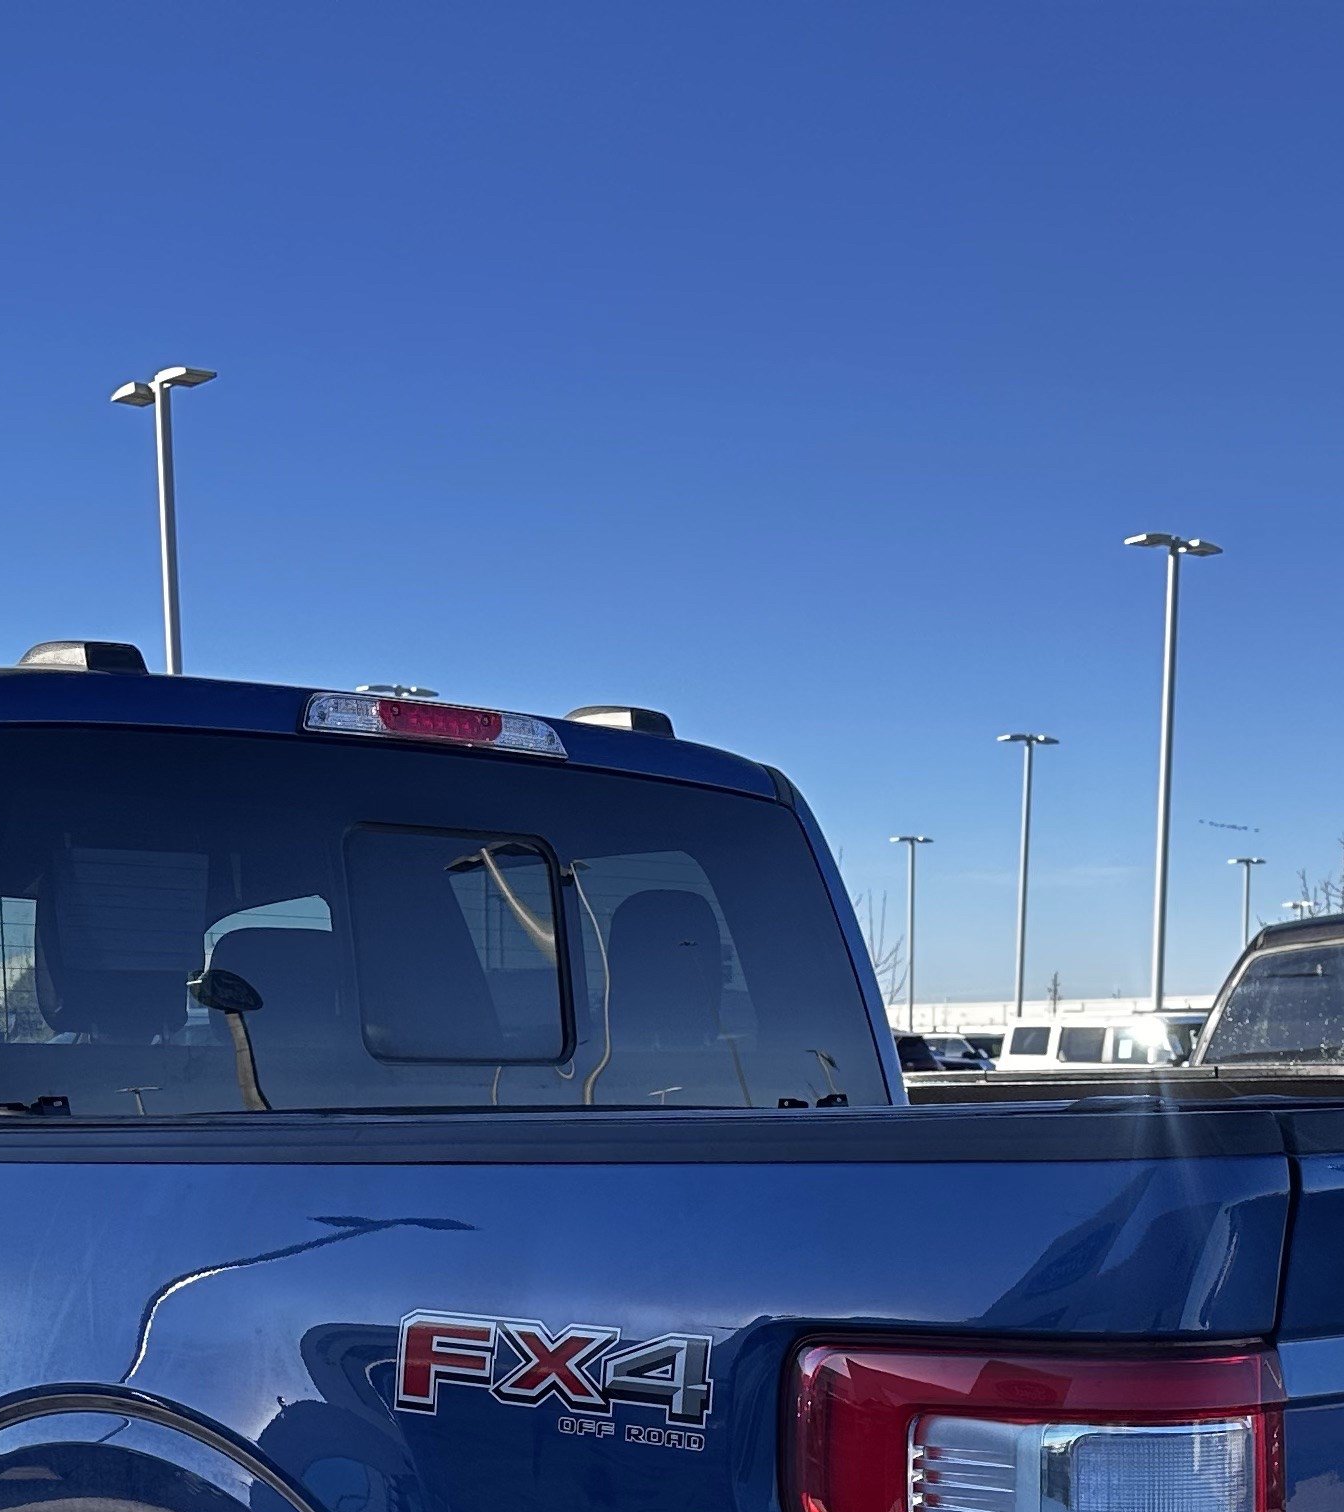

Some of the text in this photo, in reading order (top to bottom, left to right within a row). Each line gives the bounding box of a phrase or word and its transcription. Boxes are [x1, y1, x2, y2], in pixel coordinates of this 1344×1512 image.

[394, 1308, 713, 1428] FX4
[557, 1416, 705, 1452] OFF ROAD
